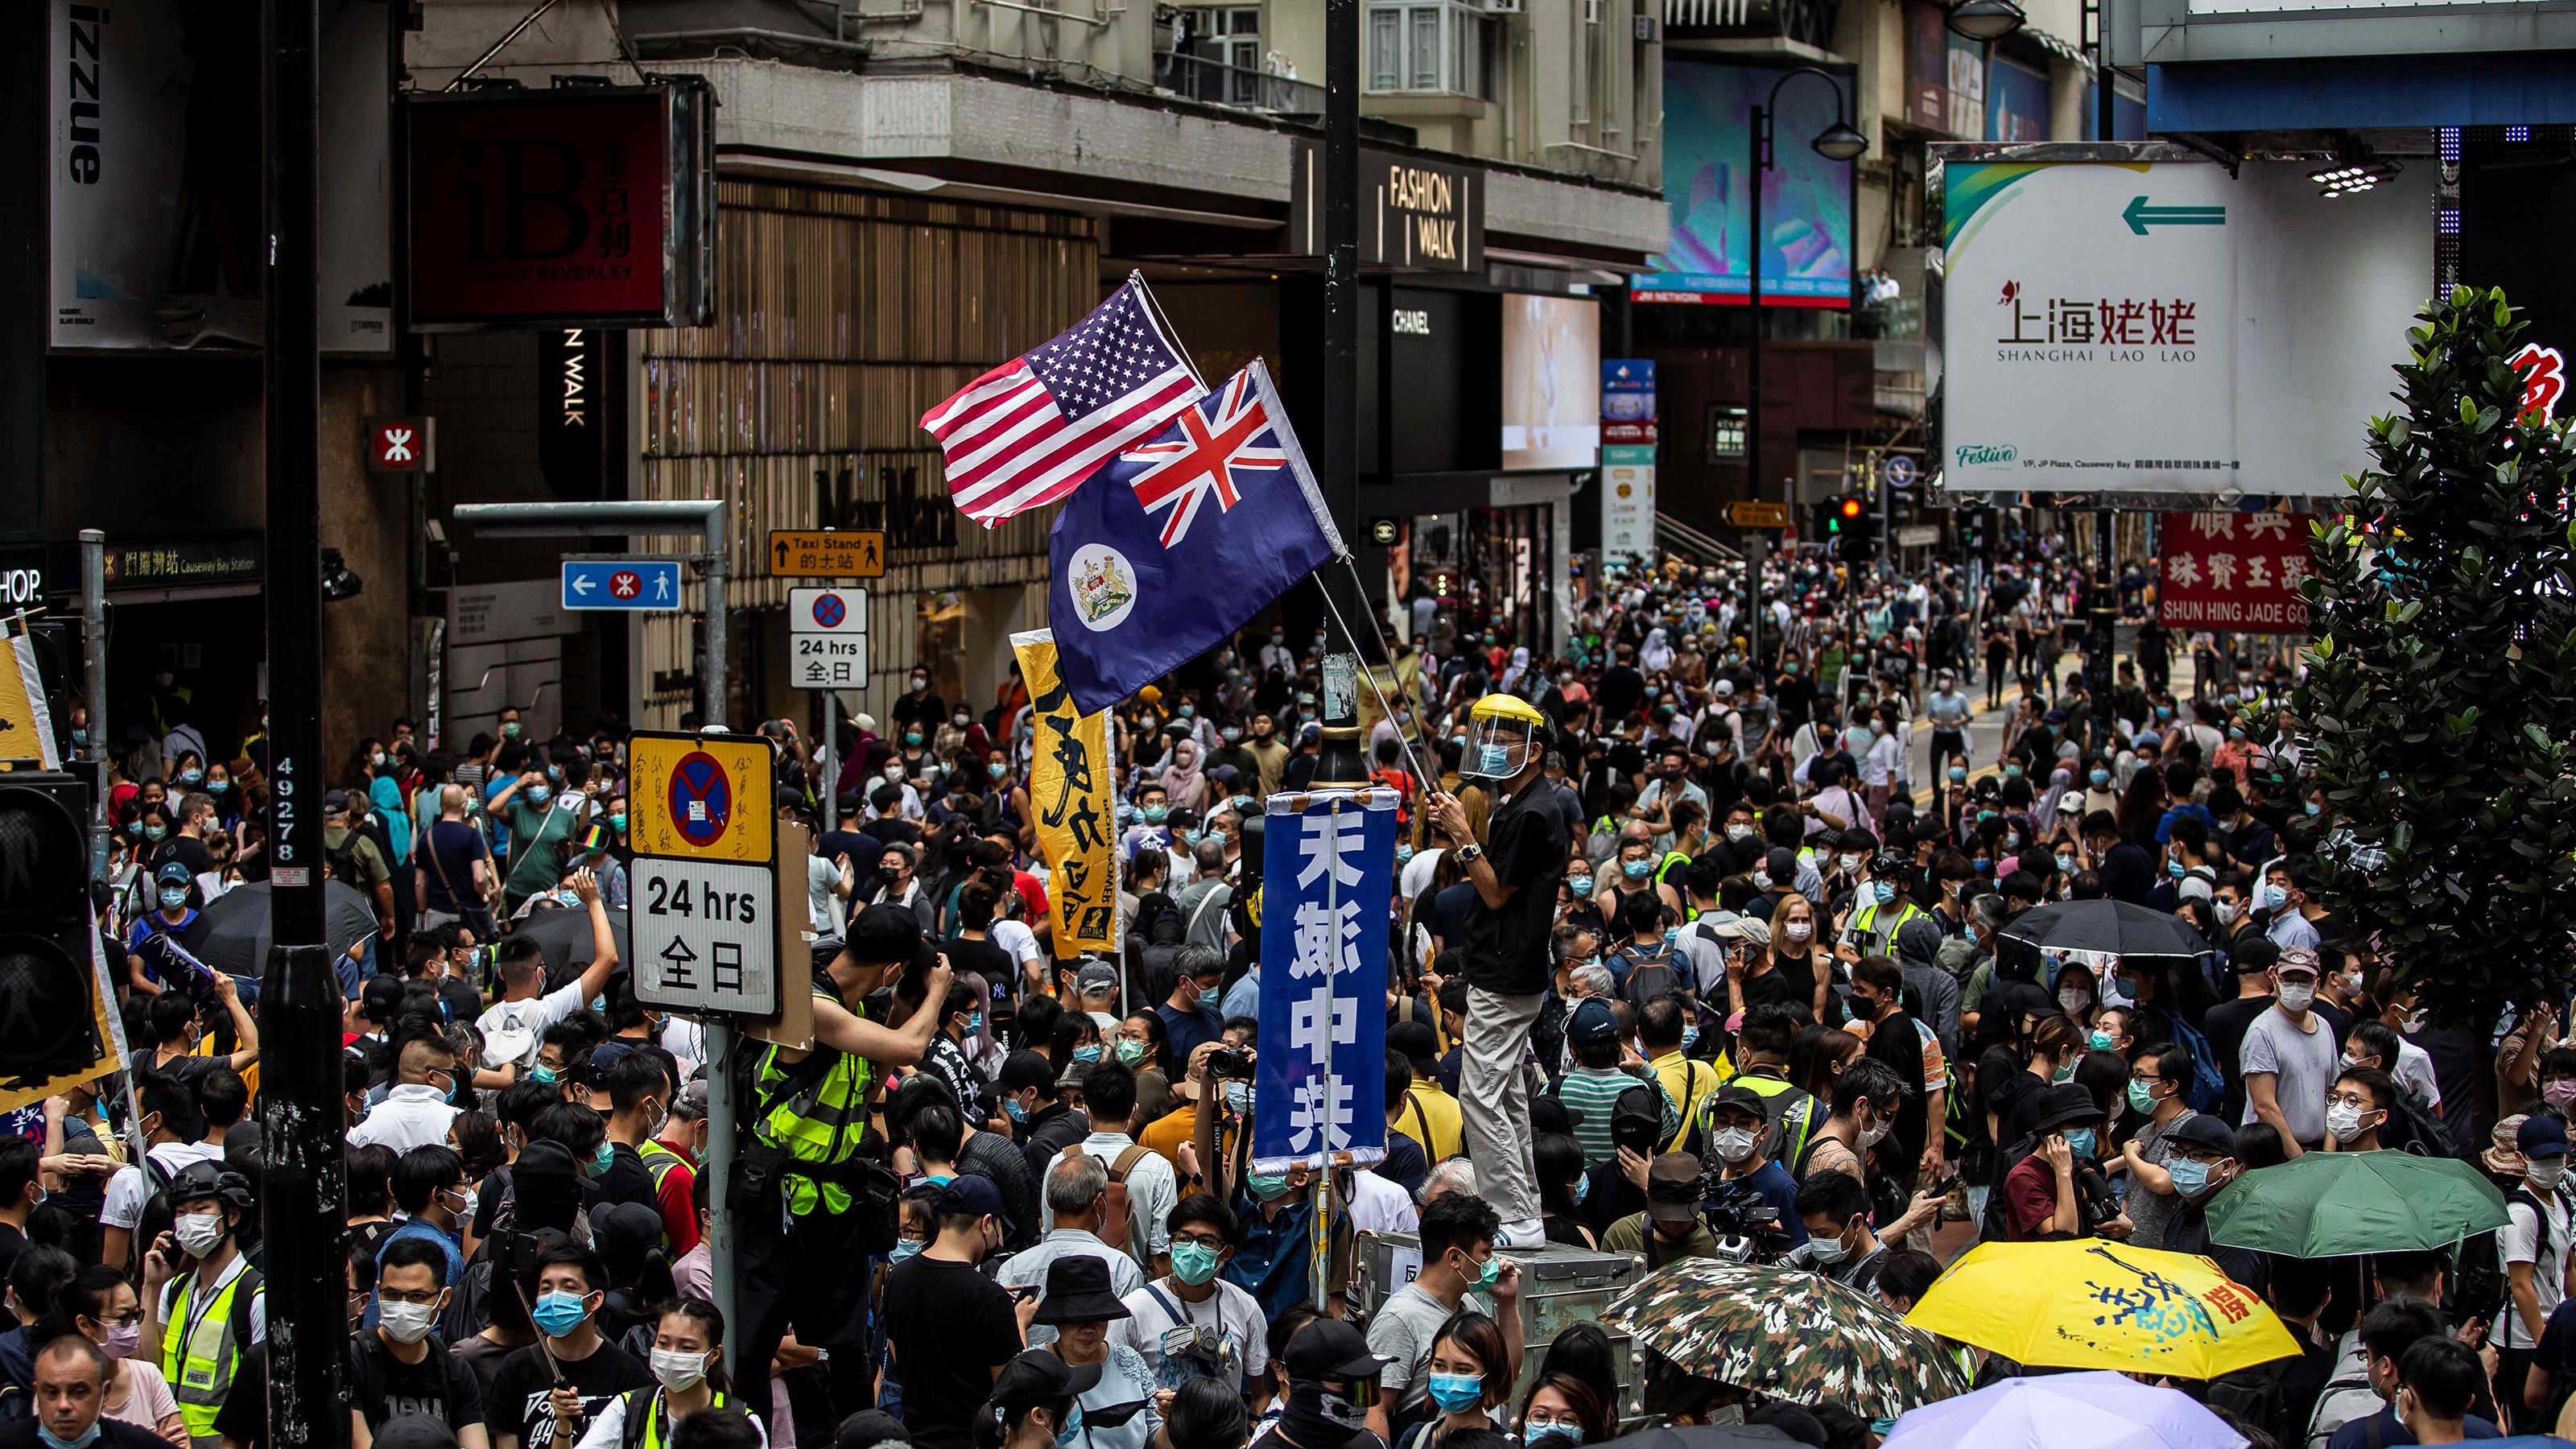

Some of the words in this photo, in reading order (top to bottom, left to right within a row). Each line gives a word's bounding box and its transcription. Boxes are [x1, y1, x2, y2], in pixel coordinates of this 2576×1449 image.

[70, 4, 110, 184] izzue
[1389, 164, 1452, 214] FASHION
[1418, 215, 1456, 260] WALK
[537, 265, 634, 281] BEVERLEY
[1393, 308, 1430, 335] CHANEL
[1997, 298, 2196, 345] 上海姥姥
[1997, 349, 2093, 362] SHANGHAI
[2110, 349, 2145, 362] LAO
[2161, 349, 2196, 362] LAO
[564, 353, 585, 427] WALK
[1956, 444, 2017, 469] Festiva
[2037, 460, 2049, 468] JP
[2050, 460, 2073, 469] Plaza,
[2074, 460, 2115, 470] Causeway
[2116, 460, 2131, 470] Bay
[793, 538, 819, 550] Taxi
[824, 538, 861, 550] Stand
[124, 549, 179, 577] 銅鑼灣站
[181, 559, 215, 574] Causeway
[217, 559, 231, 572] Bay
[231, 557, 256, 570] Station
[799, 553, 854, 570] 的士站
[2168, 551, 2310, 591] 珠寶玉器
[2163, 600, 2202, 621] SHUN
[2207, 601, 2242, 621] HING
[2245, 603, 2283, 623] JADE
[799, 639, 824, 656] 24
[829, 639, 858, 656] hrs
[806, 661, 852, 682] 全日
[277, 757, 295, 861] 49278
[647, 875, 693, 918] 24
[704, 881, 756, 924] hrs
[659, 934, 743, 996] 全日
[993, 983, 1006, 998] NY
[185, 1371, 209, 1385] PRESS
[657, 1393, 665, 1417] Canon
